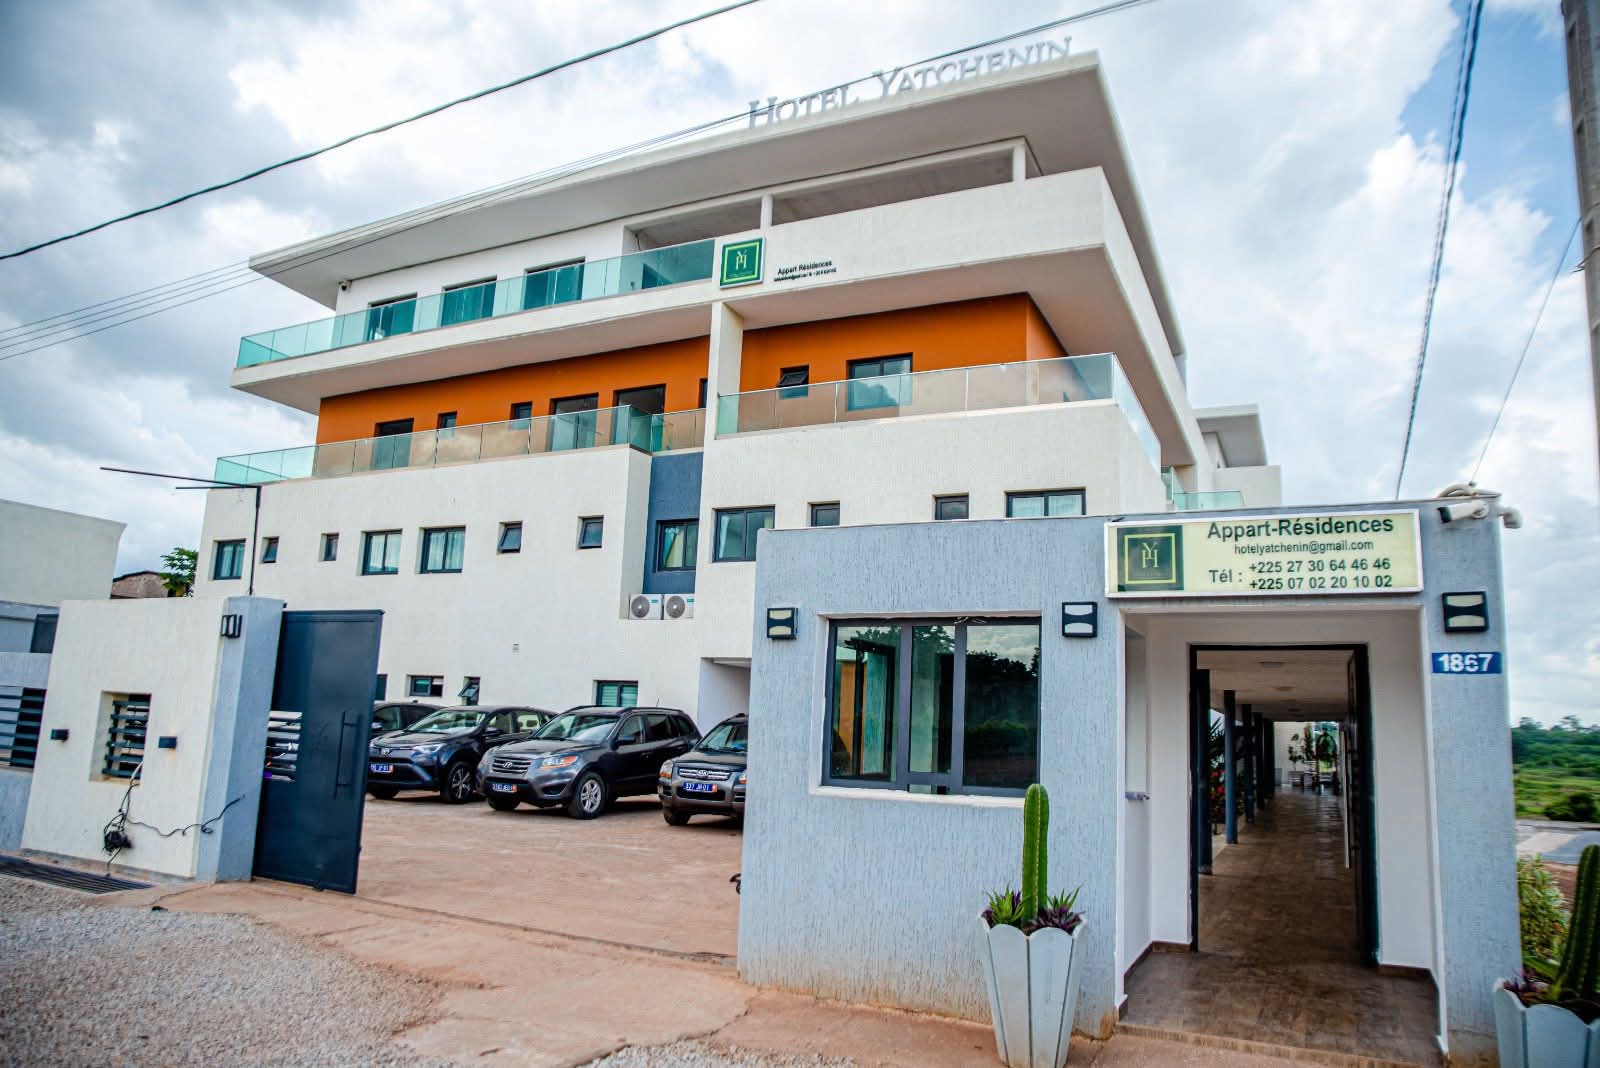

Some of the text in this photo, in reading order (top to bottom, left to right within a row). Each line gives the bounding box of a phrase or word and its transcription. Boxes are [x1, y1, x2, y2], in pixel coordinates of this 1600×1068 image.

[749, 36, 1073, 129] HOTEL YATCHENIN
[1207, 517, 1394, 542] Appart-Résidences
[1234, 541, 1374, 555] hotelyatchenin@gmail.com
[1249, 558, 1391, 574] +225 27 30 64 46 46
[1209, 568, 1233, 583] Tél
[1249, 574, 1393, 590] +225 07 02 20 10 02
[1437, 653, 1494, 672] 1867
